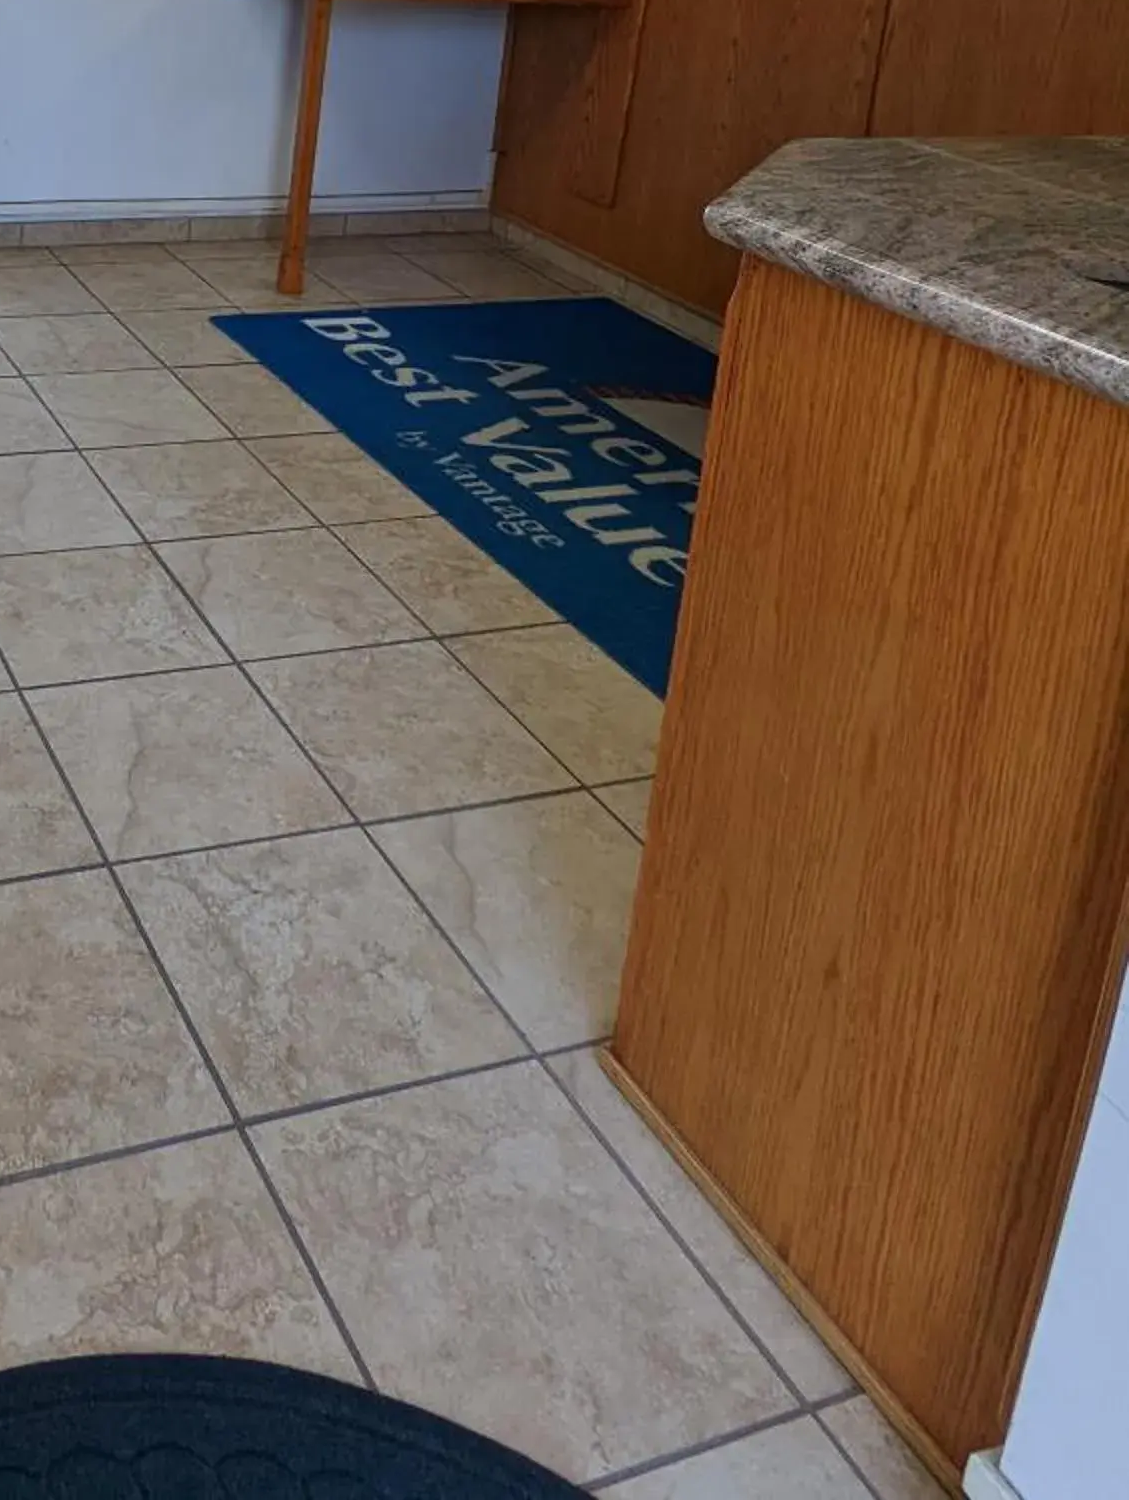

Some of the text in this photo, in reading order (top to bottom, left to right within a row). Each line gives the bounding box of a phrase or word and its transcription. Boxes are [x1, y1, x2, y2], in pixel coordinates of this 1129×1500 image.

[299, 316, 690, 588] Best Value
[394, 430, 566, 549] by Vantage
[451, 354, 700, 515] Amer
